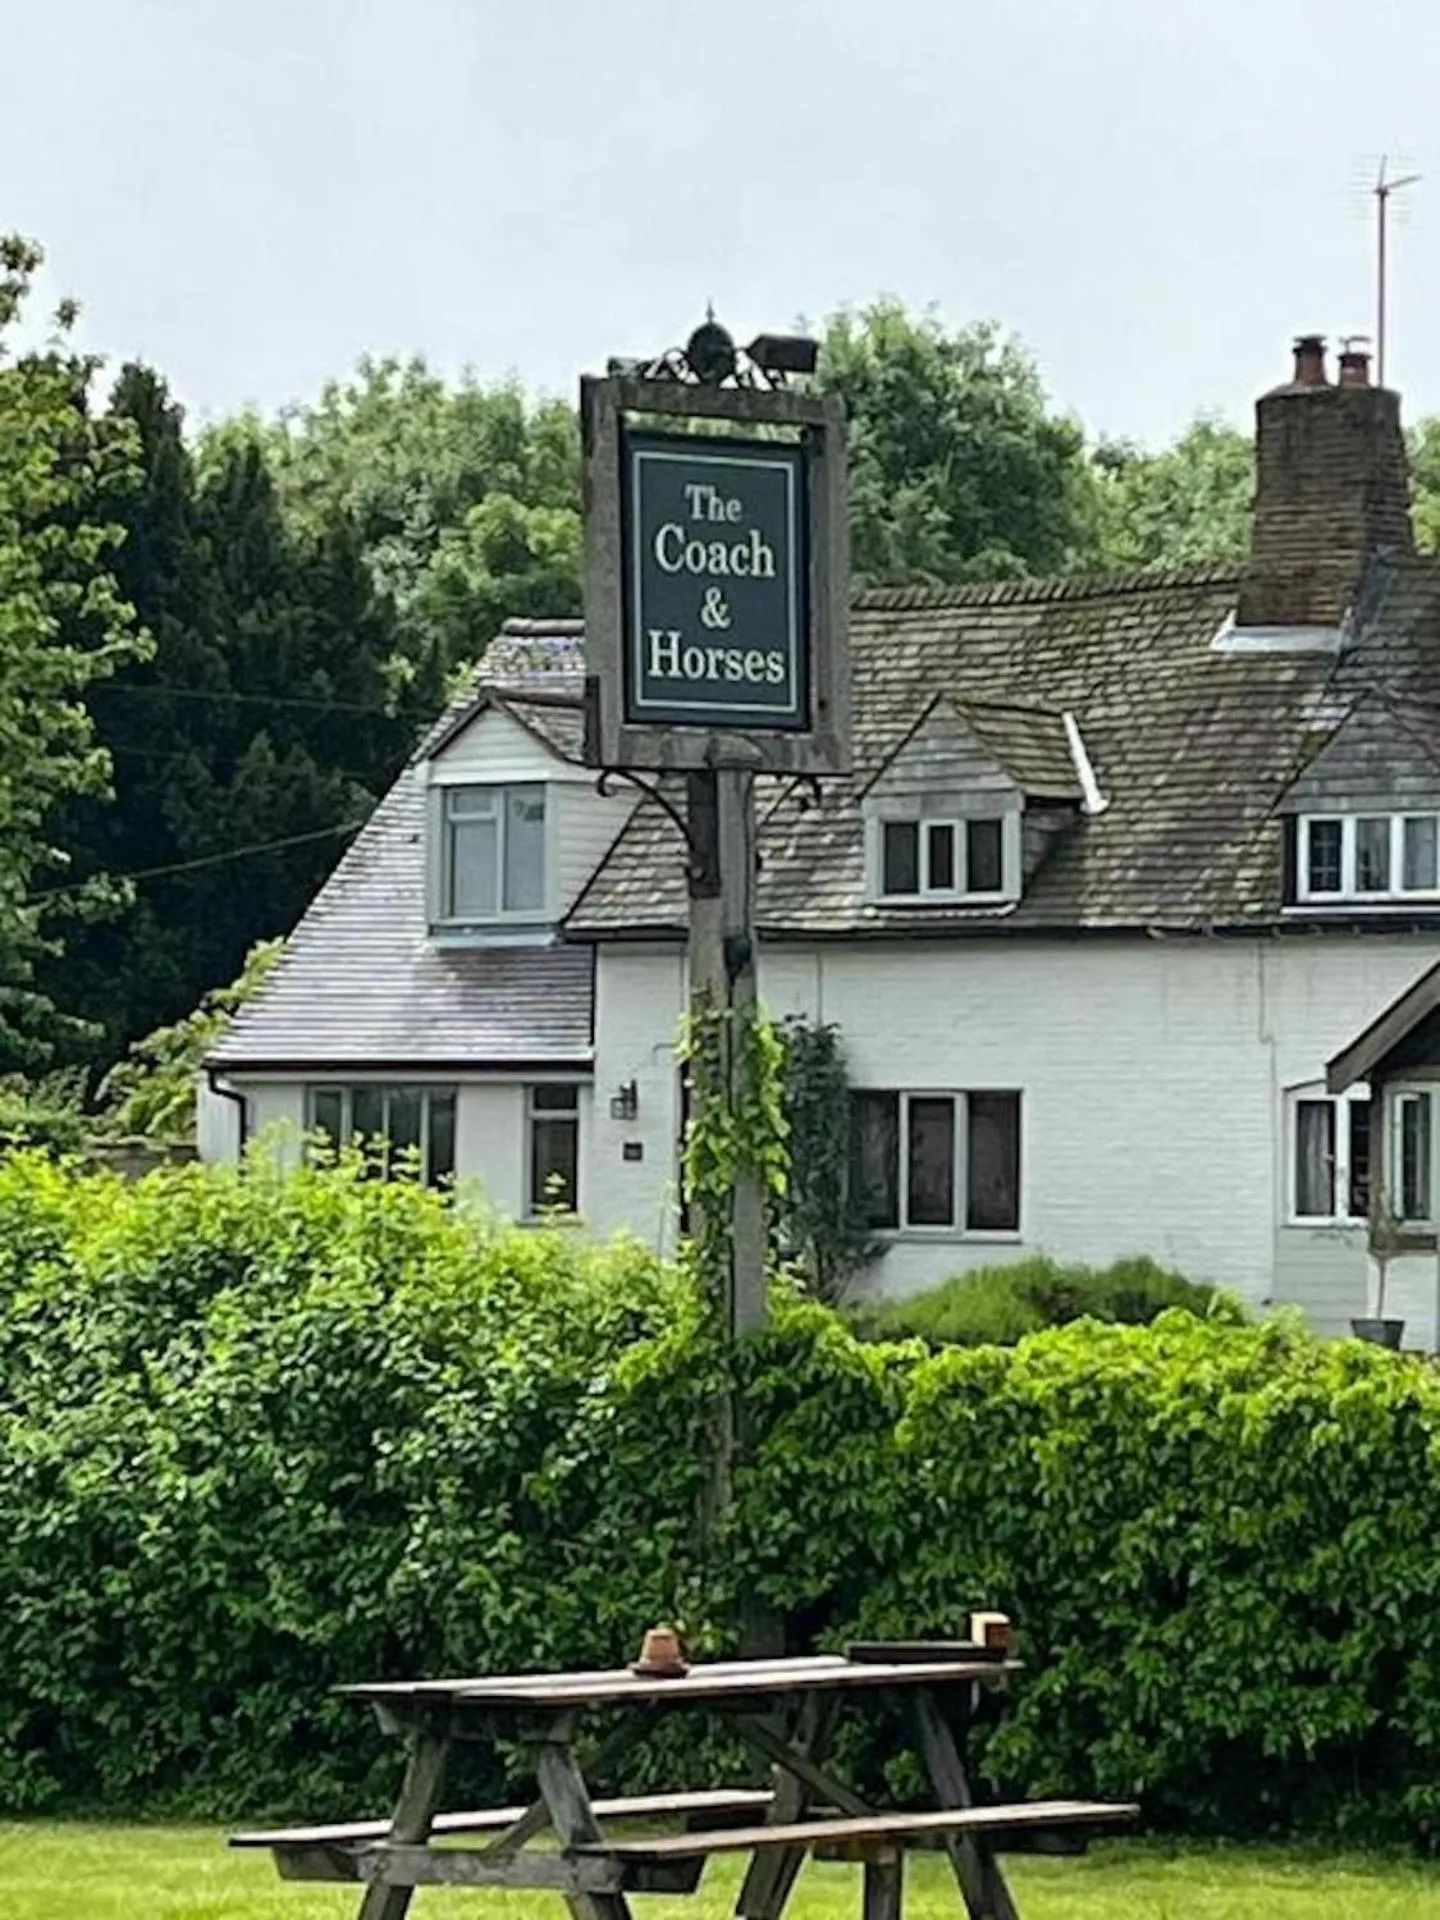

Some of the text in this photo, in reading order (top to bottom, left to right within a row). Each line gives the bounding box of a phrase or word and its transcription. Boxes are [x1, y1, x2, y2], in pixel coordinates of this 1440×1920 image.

[685, 484, 742, 522] The
[655, 523, 776, 578] Coach
[701, 587, 731, 628] &
[648, 629, 785, 683] Horses
